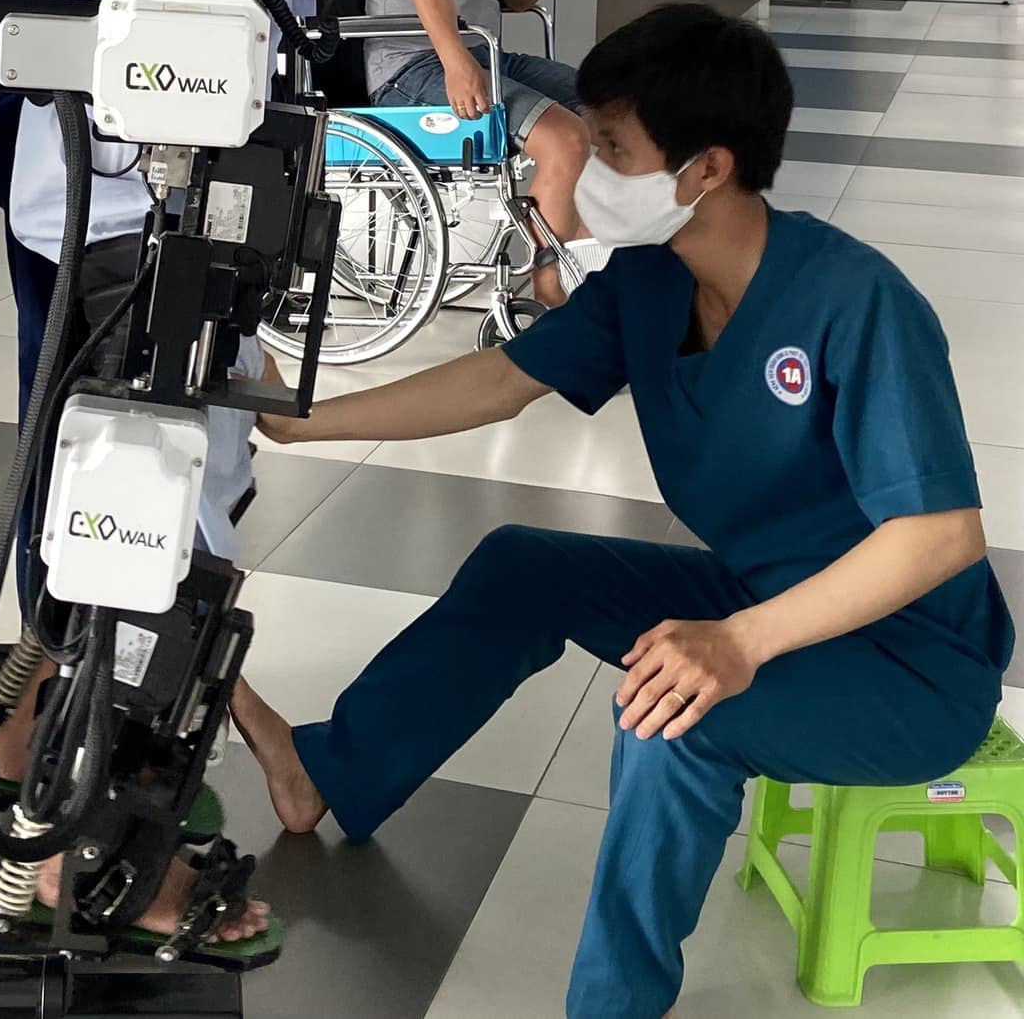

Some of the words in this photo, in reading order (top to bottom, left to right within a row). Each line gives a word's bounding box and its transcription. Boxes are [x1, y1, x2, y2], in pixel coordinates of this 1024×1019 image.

[177, 77, 228, 94] WALK
[782, 367, 802, 386] 1A
[118, 528, 167, 550] WALK
